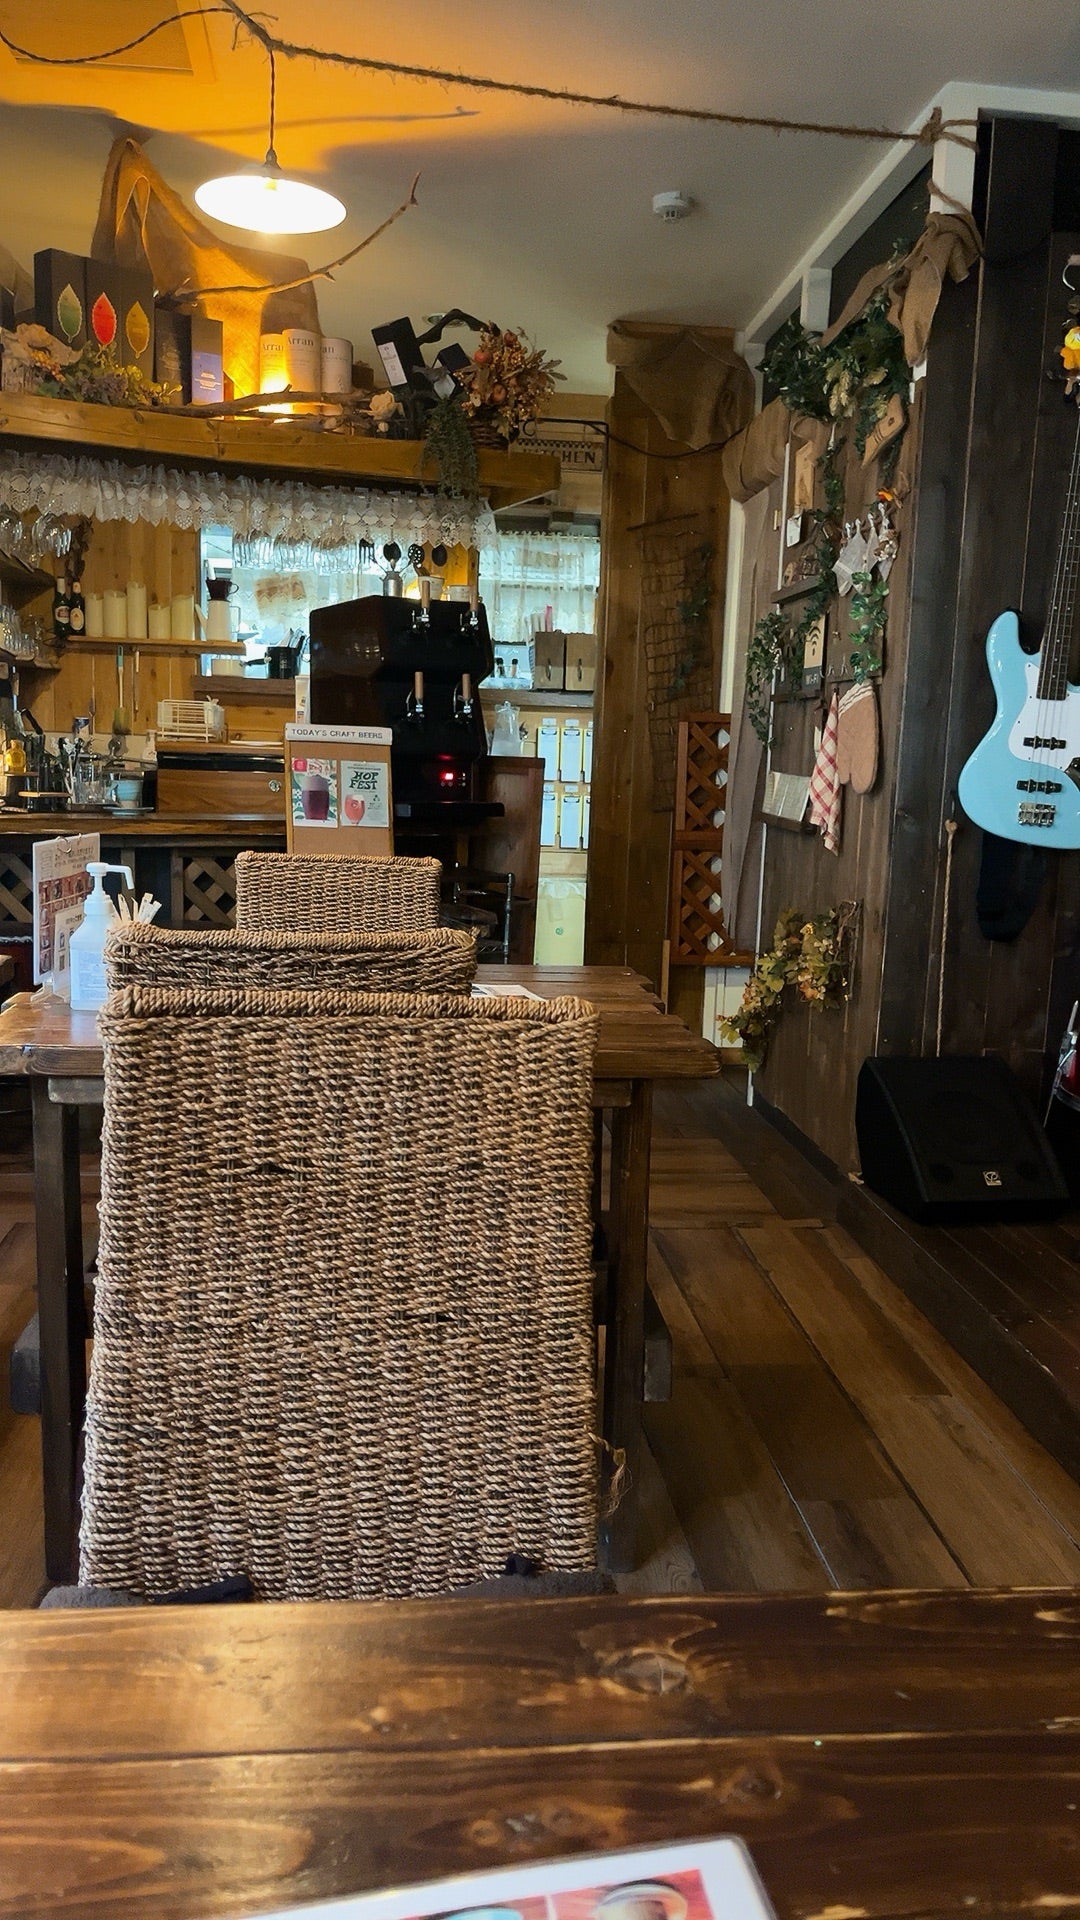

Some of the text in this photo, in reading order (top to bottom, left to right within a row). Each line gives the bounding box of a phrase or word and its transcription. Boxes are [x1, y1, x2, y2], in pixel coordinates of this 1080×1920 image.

[287, 337, 314, 346] Arran
[292, 728, 383, 740] TODAY'S CRAFT BEERS
[352, 771, 379, 781] HOP
[349, 779, 378, 790] FEST
